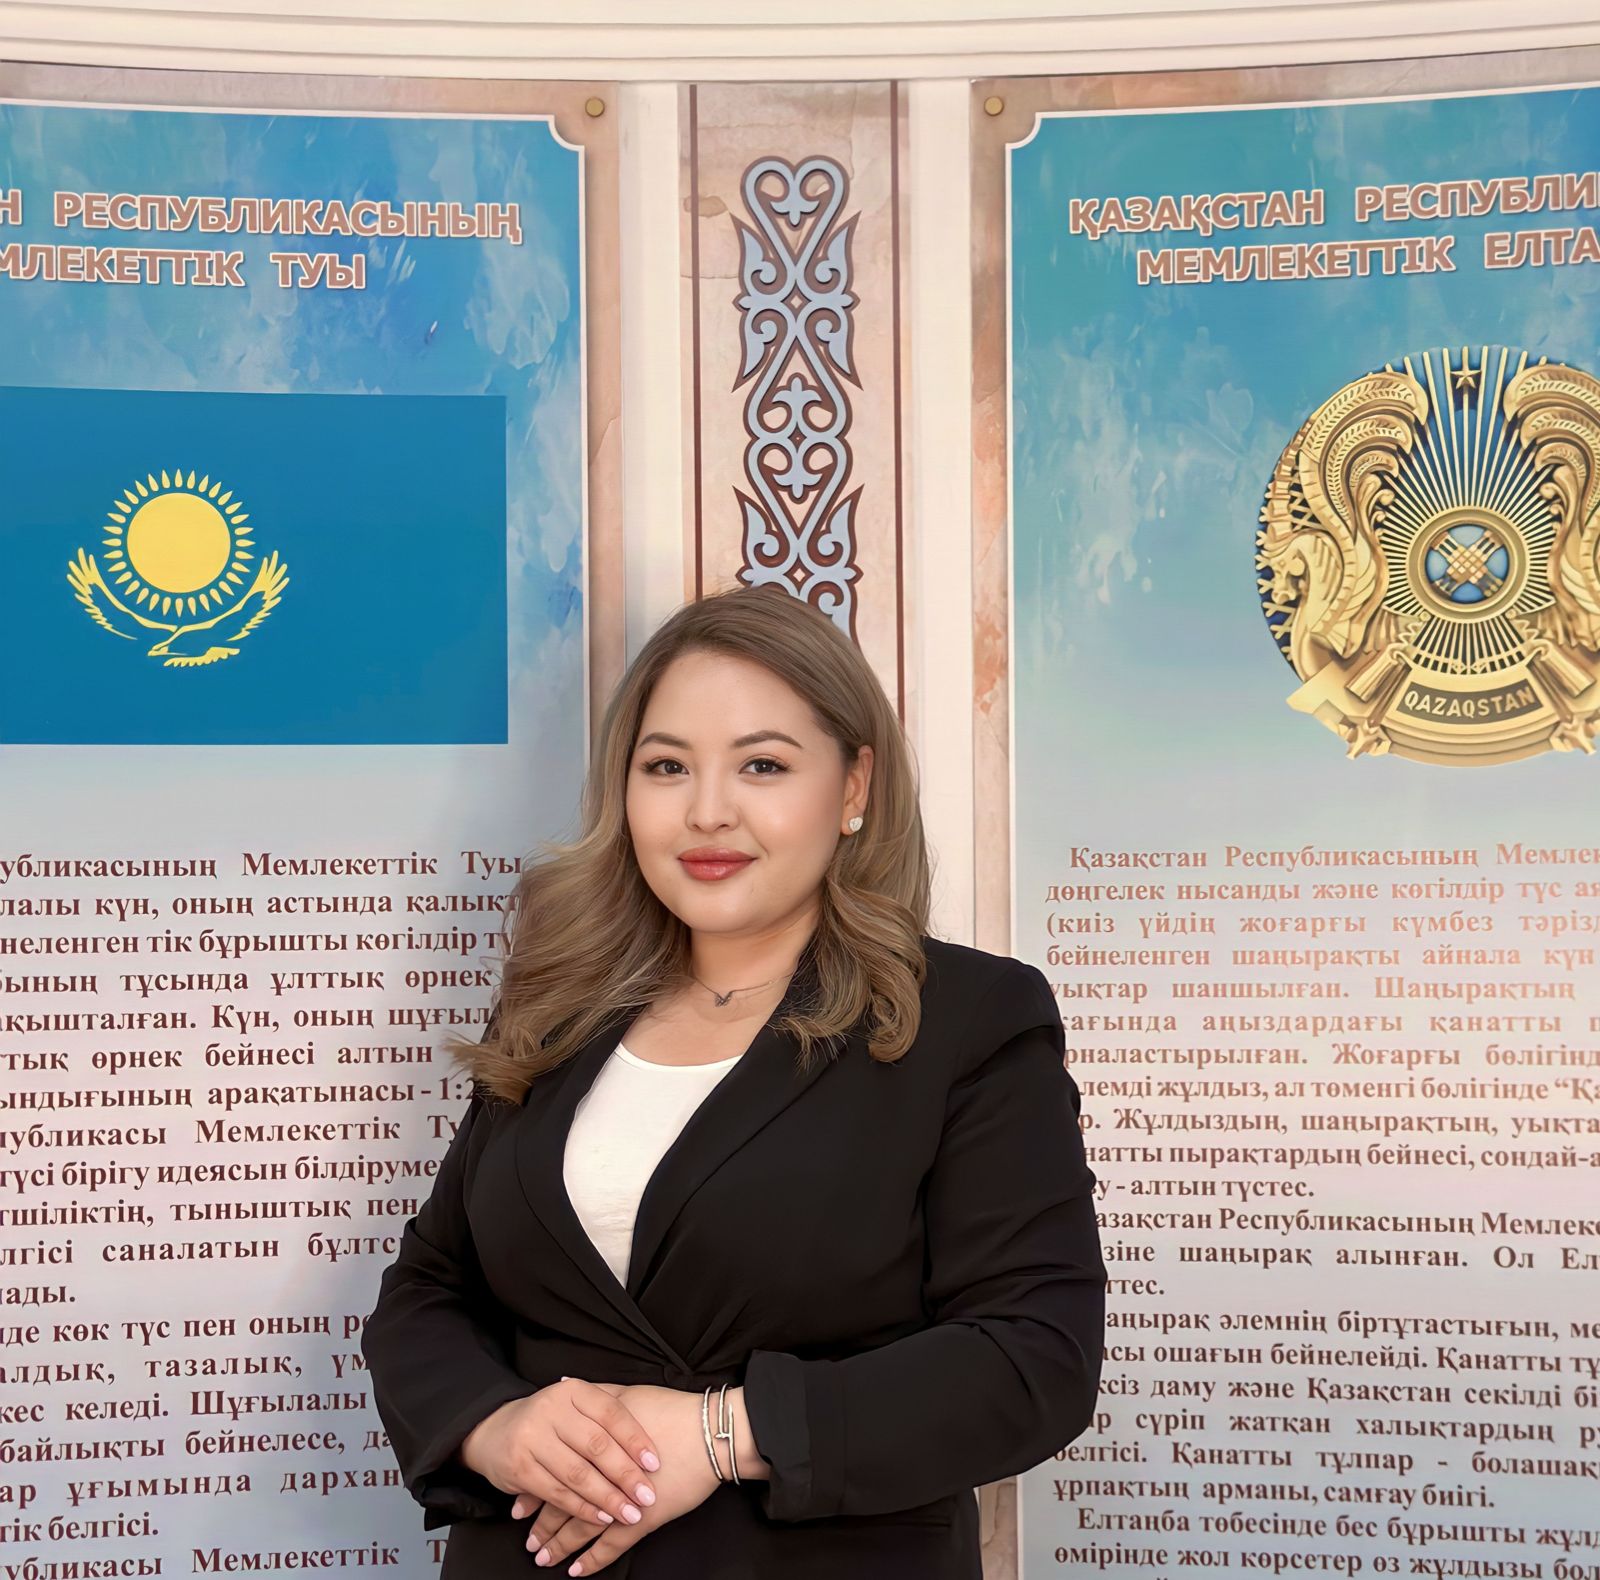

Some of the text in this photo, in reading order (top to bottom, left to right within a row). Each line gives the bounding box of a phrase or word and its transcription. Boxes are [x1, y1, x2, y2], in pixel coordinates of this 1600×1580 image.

[53, 192, 523, 244] РЕСПУБЛИКАСЫНЫҢ
[1069, 172, 1600, 240] ҚАЗАҚСТАН РЕСПУБЛИ
[270, 252, 366, 289] ТУЫ
[1137, 236, 1455, 285] МЕМЛЕКЕТТІК
[1404, 686, 1536, 717] QAZAQSTAN
[242, 852, 437, 875] Мемлекеттік
[1071, 846, 1478, 872] Қазақстан Республикасының
[1045, 877, 1562, 904] дөңгелек нысанды және көгілдір түс
[96, 899, 158, 921] күн,
[173, 898, 253, 916] оның
[268, 896, 392, 915] астында
[1047, 910, 1600, 938] (киіз үйдің жоғарғы күмбез тәріз
[1, 927, 476, 958] неленген тік бұрышты көгілдір
[1047, 944, 1594, 971] бейнеленген шаңырақты айнала күн
[0, 970, 492, 998] ының тұсында ұлттық өрнек
[1173, 983, 1349, 998] шаншылған.
[1375, 977, 1575, 1004] Шаңырақтың
[0, 1013, 196, 1034] қышталған.
[212, 1005, 279, 1034] Күн,
[294, 1010, 373, 1027] оның
[1203, 1016, 1402, 1037] аңыздардағы
[1430, 1016, 1560, 1034] қанатты
[0, 1042, 432, 1075] тық өрнек бейнесі алтын
[1332, 1043, 1459, 1071] Жоғарғы
[208, 1085, 413, 1111] арақатынасы
[1158, 1082, 1268, 1102] жұлдыз,
[1275, 1082, 1304, 1096] ал
[1311, 1077, 1414, 1097] төменгі
[1421, 1077, 1548, 1100] бөлігінде
[196, 1117, 400, 1143] Мемлекеттік
[1114, 1109, 1287, 1135] Жұлдыздың,
[1302, 1116, 1497, 1137] шаңырақтың,
[1170, 1148, 1361, 1169] пырақтардың
[1367, 1144, 1474, 1169] бейнесі,
[62, 1161, 149, 1192] бірігу
[158, 1164, 286, 1185] идеясын
[295, 1155, 442, 1184] білдіруме
[1131, 1180, 1216, 1195] алтын
[1222, 1181, 1314, 1202] түстес.
[170, 1200, 351, 1221] тыныштық
[368, 1199, 417, 1215] пен
[1220, 1208, 1474, 1235] Республикасының
[103, 1241, 278, 1262] саналатын
[308, 1232, 402, 1262] бұлтс
[1180, 1247, 1312, 1269] шаңырақ
[1337, 1249, 1467, 1266] алынған.
[1494, 1246, 1533, 1268] Ол
[0, 1286, 75, 1307] ады.
[54, 1317, 330, 1346] көк түс пен оның
[1220, 1310, 1327, 1333] әлемнің
[1338, 1311, 1558, 1340] біртұтастығын,
[145, 1356, 301, 1377] тазалық,
[1154, 1347, 1261, 1363] ошағын
[1271, 1343, 1427, 1369] бейнелейді.
[1437, 1347, 1560, 1373] Қанатты
[66, 1393, 168, 1420] келеді.
[191, 1391, 366, 1420] Шұғылалы
[1151, 1381, 1215, 1402] даму
[1228, 1382, 1294, 1398] және
[1308, 1378, 1450, 1403] Қазақстан
[1465, 1384, 1560, 1408] секілді
[1136, 1408, 1554, 1445] сүріп жатқан халықтардың
[186, 1430, 344, 1454] бейнелесе,
[1173, 1442, 1291, 1468] Қанатты
[1316, 1452, 1413, 1476] тұлпар
[67, 1475, 250, 1506] ұғымында
[1054, 1480, 1494, 1510] ұрпақтың арманы, самғау биігі.
[49, 1512, 158, 1540] белгісі.
[1079, 1508, 1525, 1545] Елтаңба төбесінде бес бұрышты
[192, 1542, 399, 1573] Мемлекеттік
[1055, 1543, 1167, 1569] өмірінде
[1178, 1551, 1229, 1566] жол
[1242, 1552, 1362, 1577] көрсетер
[1373, 1557, 1399, 1572] өз
[1410, 1558, 1542, 1580] жұлдызы
